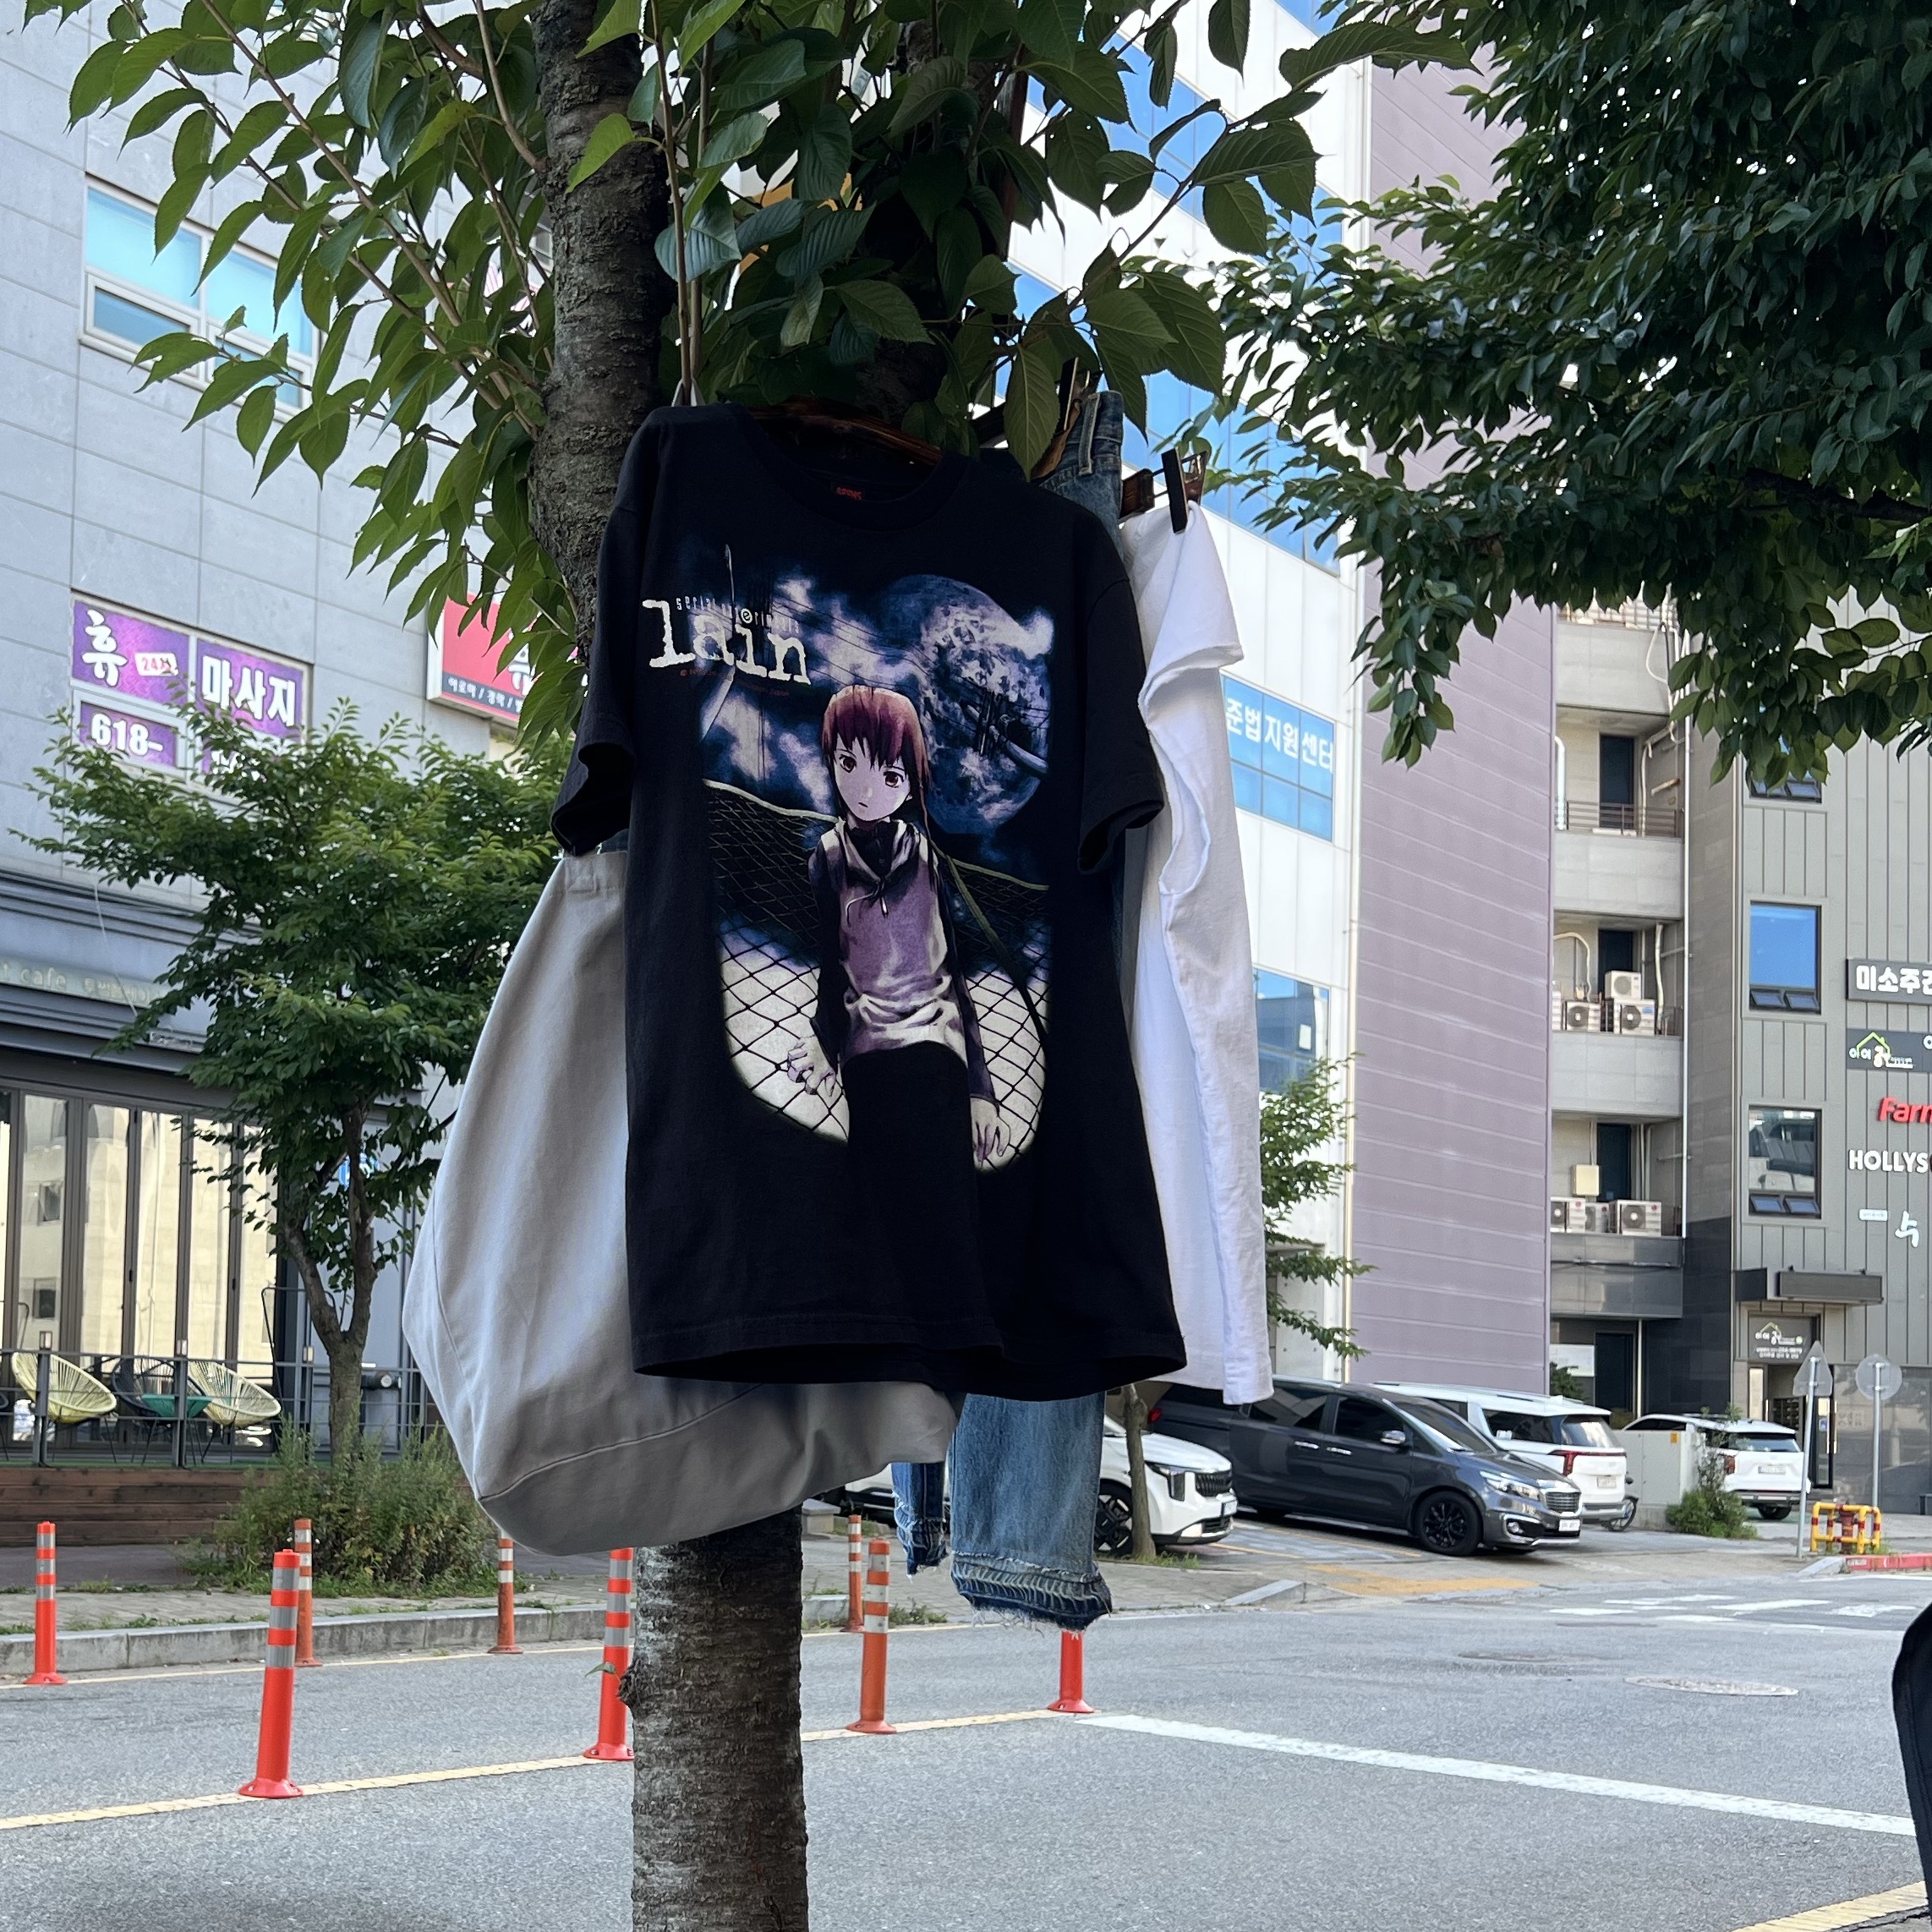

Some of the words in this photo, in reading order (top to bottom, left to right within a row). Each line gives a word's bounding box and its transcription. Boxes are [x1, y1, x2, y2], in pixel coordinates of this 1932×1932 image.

[81, 609, 129, 687] 휴
[201, 654, 296, 727] 마사지
[642, 599, 812, 685] lain
[1225, 697, 1333, 774] 준법지원센터
[20, 966, 67, 988] cafe
[1848, 1149, 1928, 1174] HOLLYS
